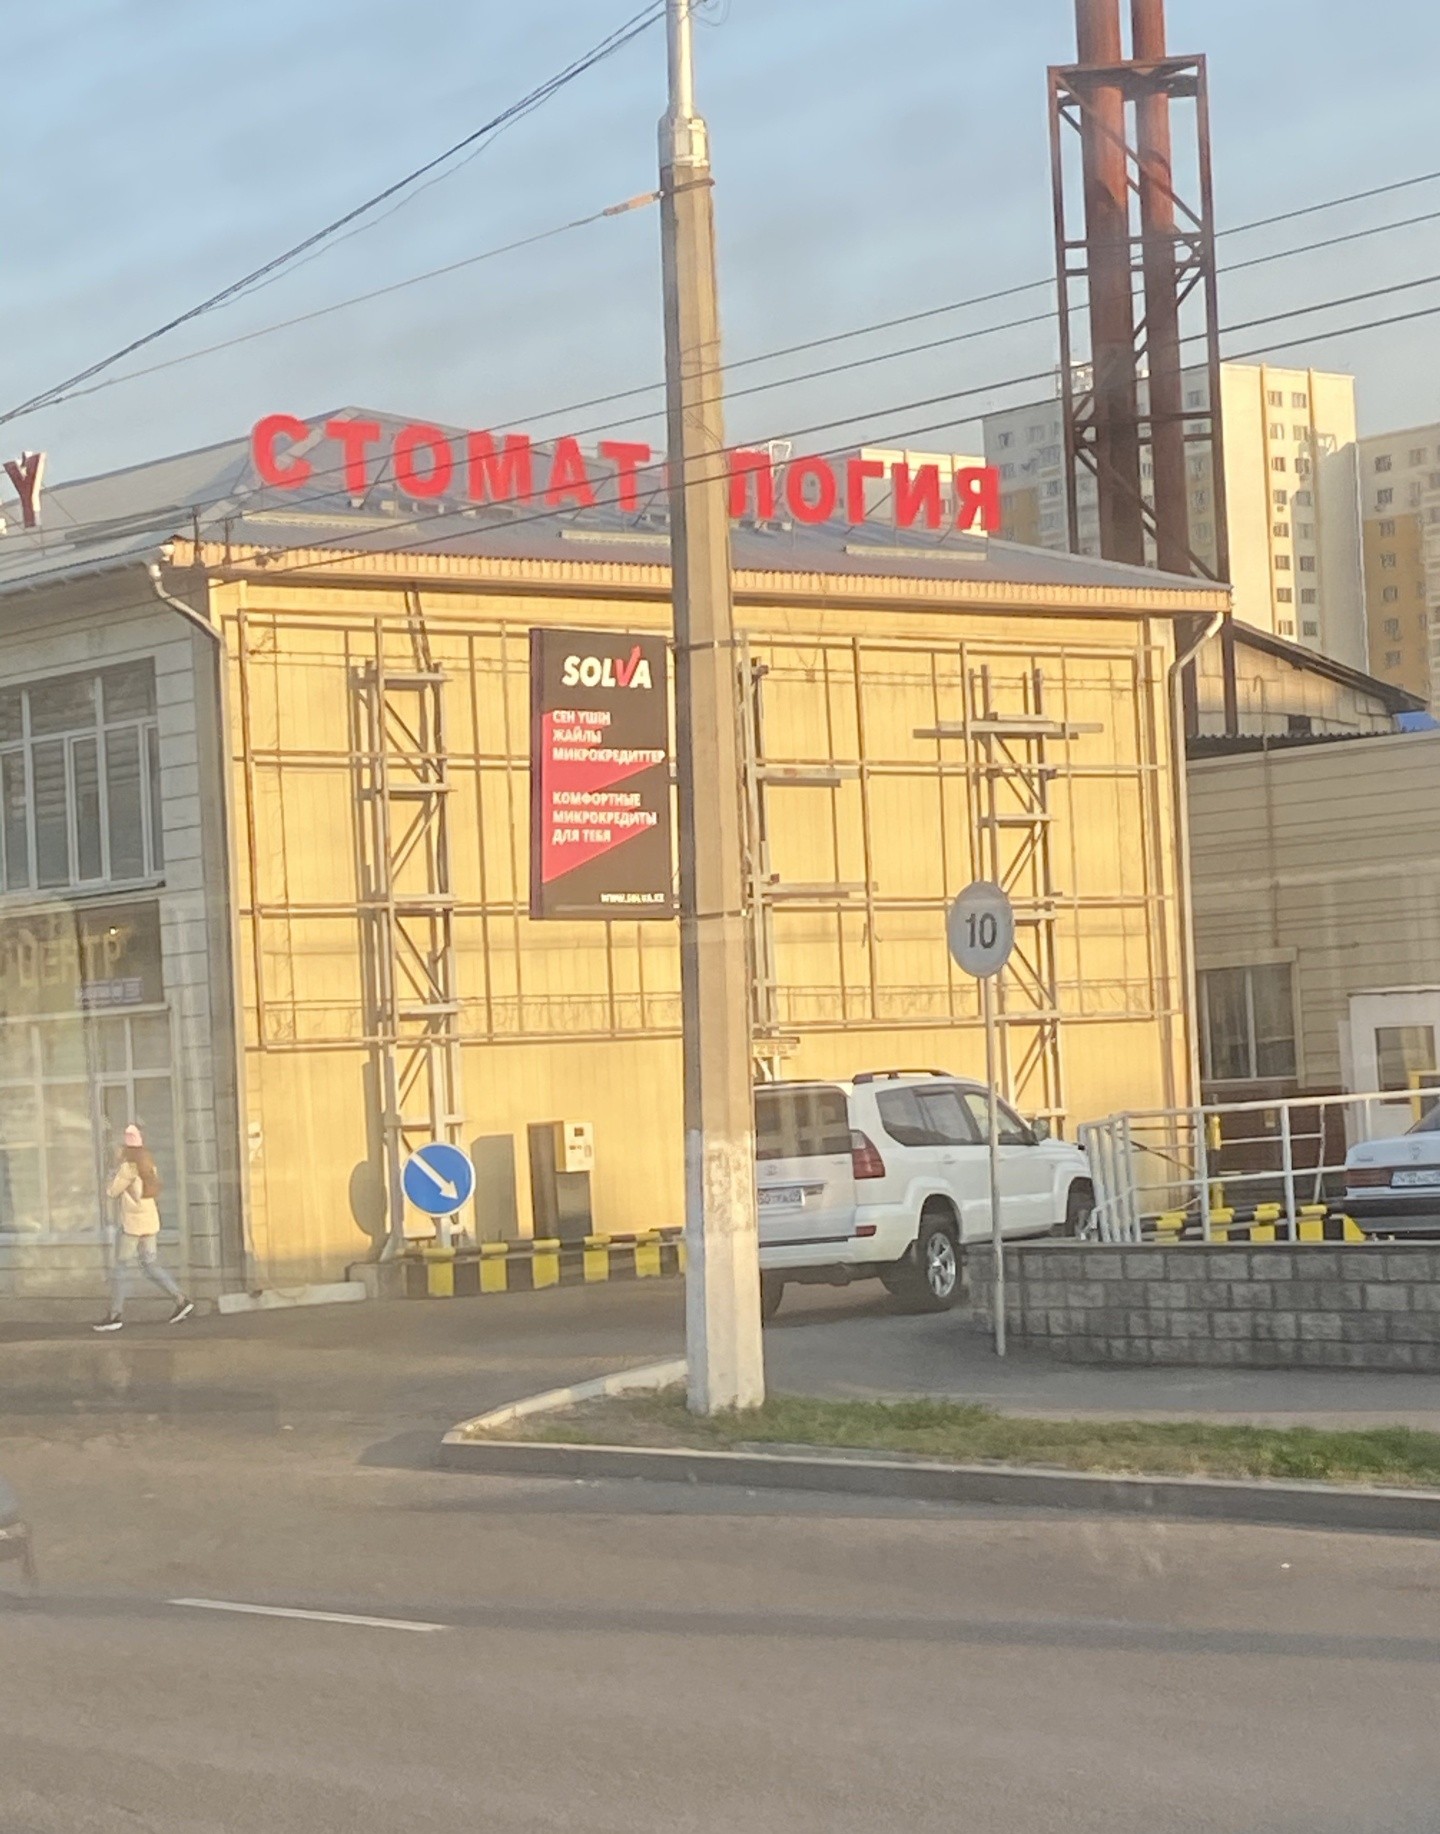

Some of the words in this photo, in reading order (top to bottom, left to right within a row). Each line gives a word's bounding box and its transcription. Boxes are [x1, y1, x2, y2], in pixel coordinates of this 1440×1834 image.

[252, 413, 1001, 532] СТОМАТЛОГИЯ
[561, 645, 652, 688] SOLVA
[552, 710, 575, 724] СЕН
[552, 726, 602, 743] ЖАЙЛЫ
[552, 791, 641, 807] КОМФОРТНЫЕ
[552, 810, 657, 828] МИКРОКРЕДИТЫ
[552, 829, 580, 845] ДЛЯ
[582, 829, 611, 843] ТЕБЯ
[965, 913, 998, 949] 10
